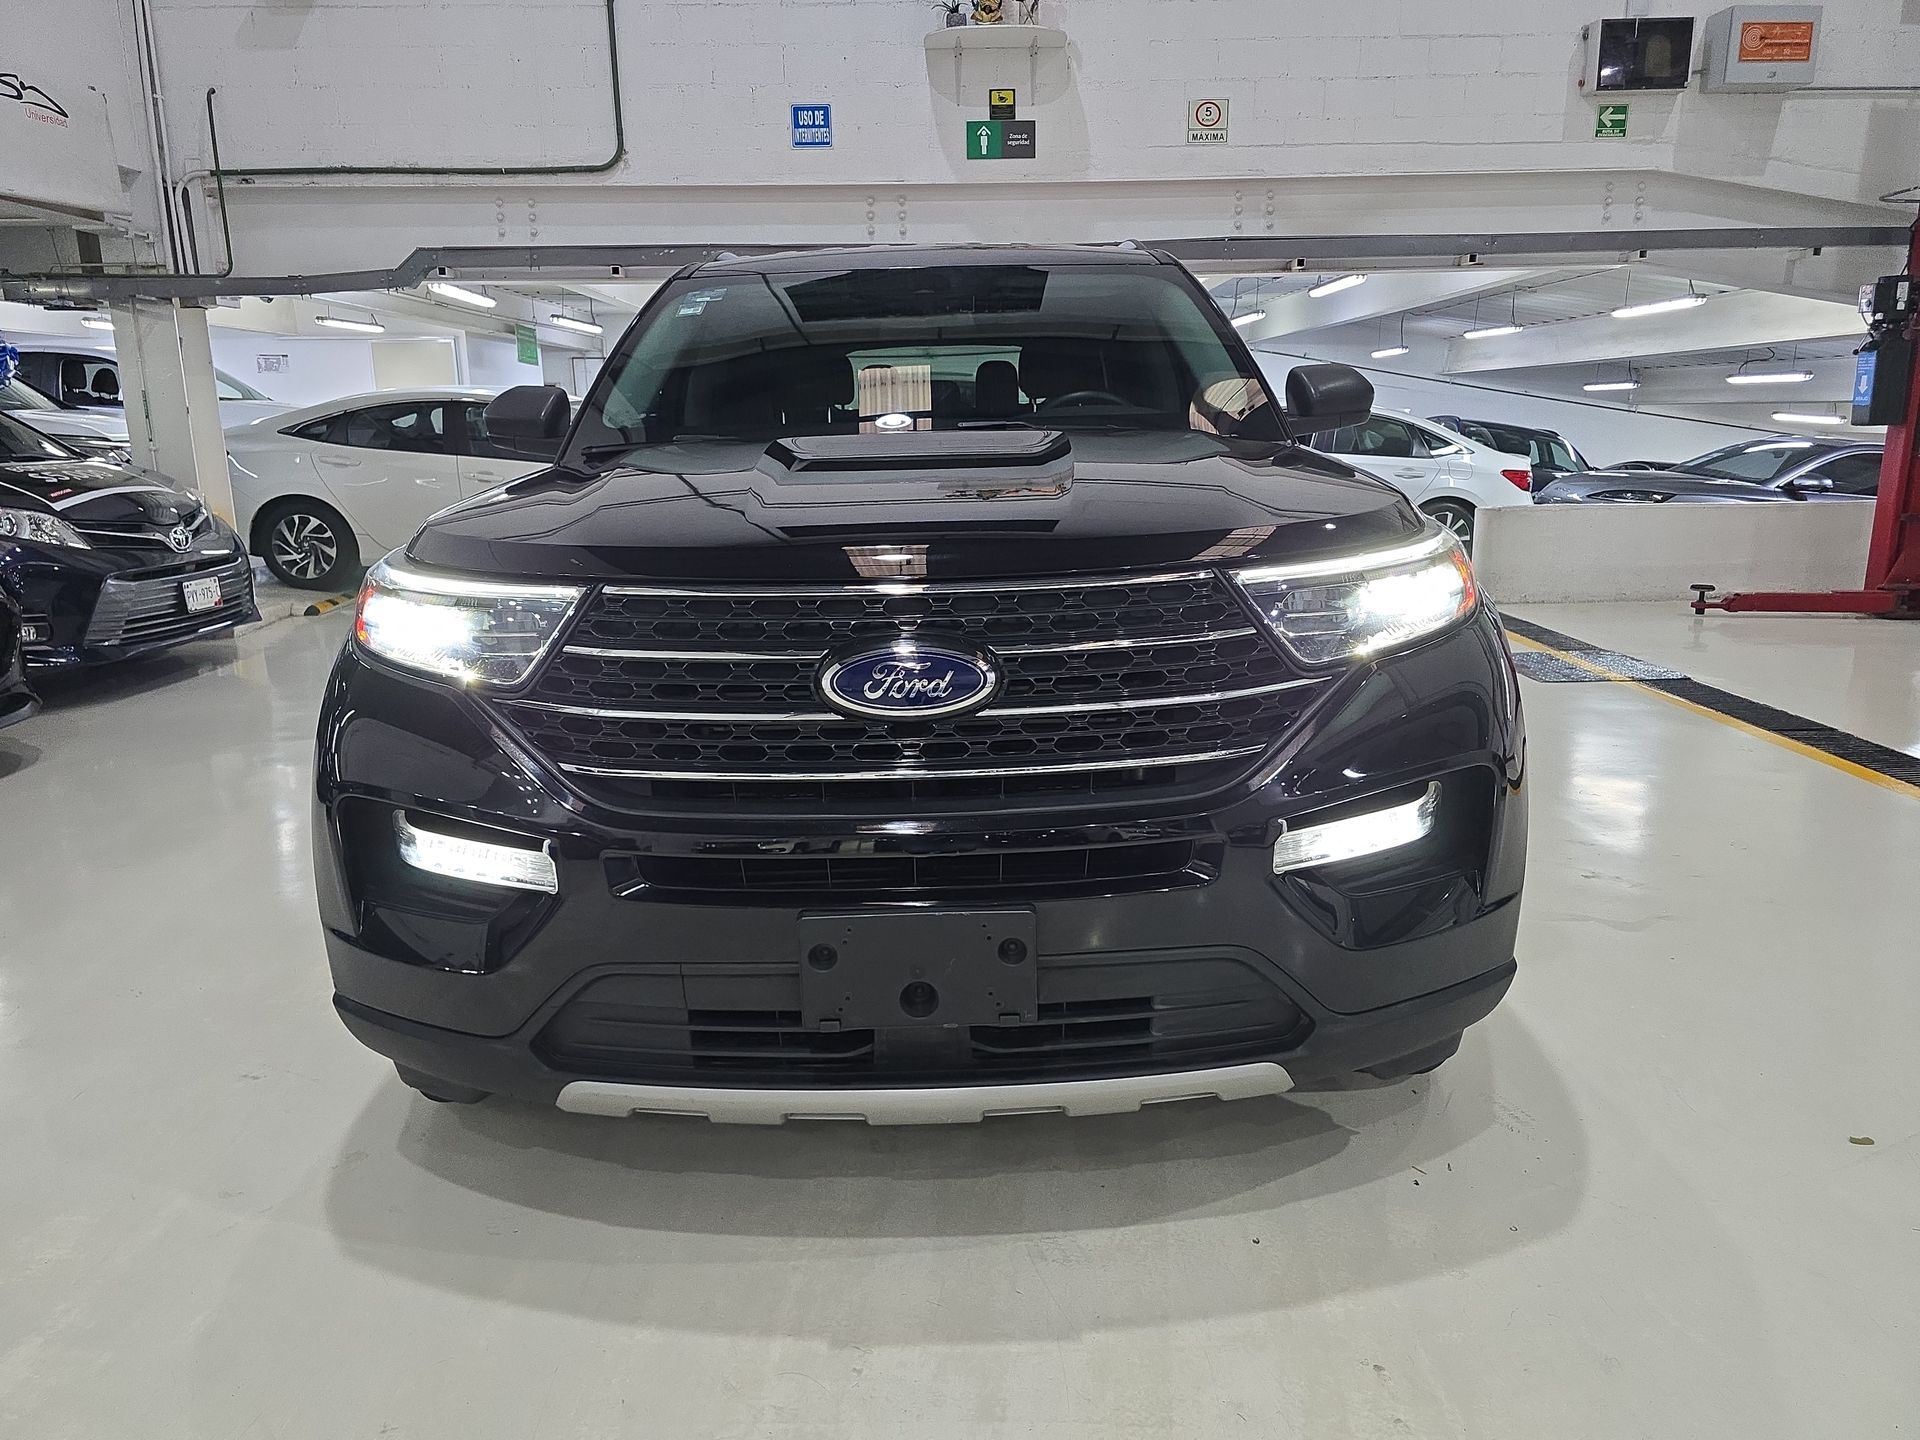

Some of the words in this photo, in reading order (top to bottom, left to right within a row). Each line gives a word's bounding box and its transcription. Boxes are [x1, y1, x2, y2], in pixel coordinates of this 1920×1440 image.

[25, 108, 68, 128] Universidad
[798, 110, 813, 125] USO
[815, 110, 825, 125] DE
[1205, 107, 1212, 117] 5
[1192, 131, 1225, 141] MÁXIMA
[863, 661, 954, 699] Ford
